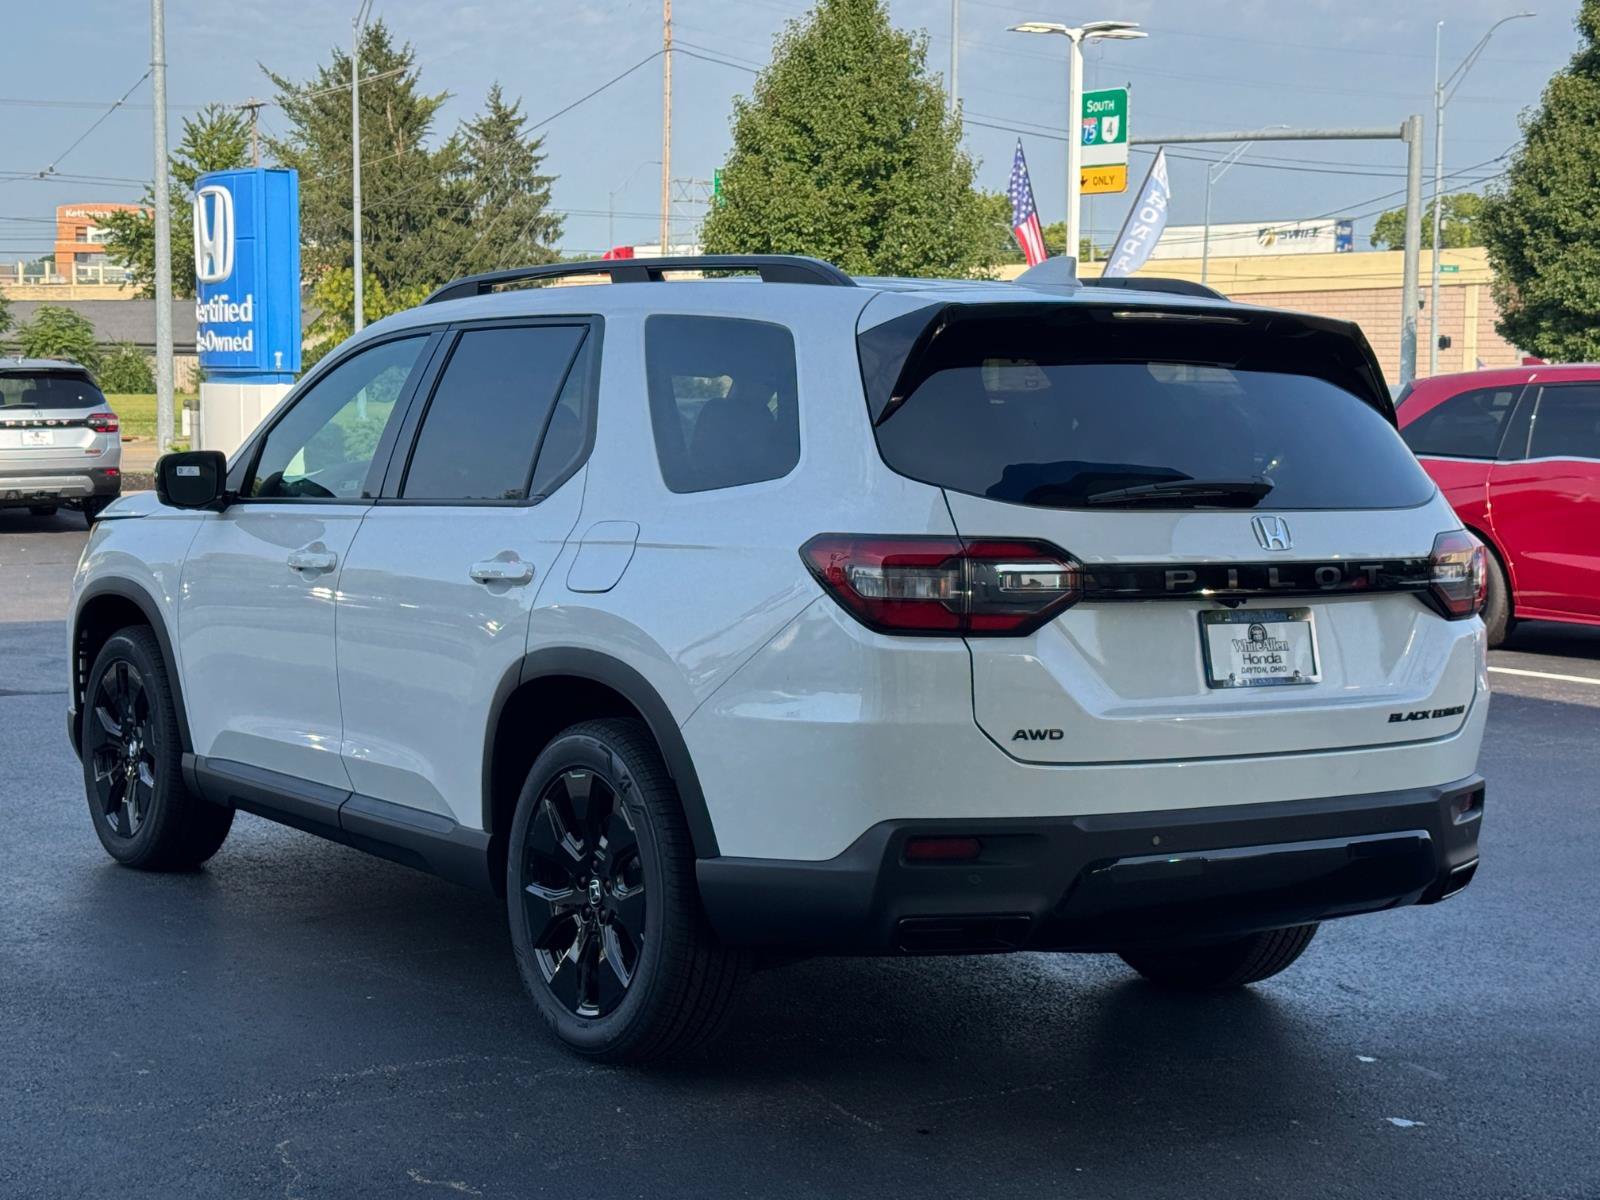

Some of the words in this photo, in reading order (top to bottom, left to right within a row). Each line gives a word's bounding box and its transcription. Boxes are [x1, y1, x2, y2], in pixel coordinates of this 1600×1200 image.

[1086, 100, 1115, 113] SOUTH
[1084, 125, 1096, 140] 75
[1106, 122, 1113, 136] 4
[1093, 175, 1115, 186] ONLY
[1165, 564, 1384, 591] PILOT
[1242, 653, 1283, 665] Honda
[1270, 665, 1288, 673] OHIO
[1387, 709, 1432, 724] BLACK
[1011, 728, 1065, 741] AWD
